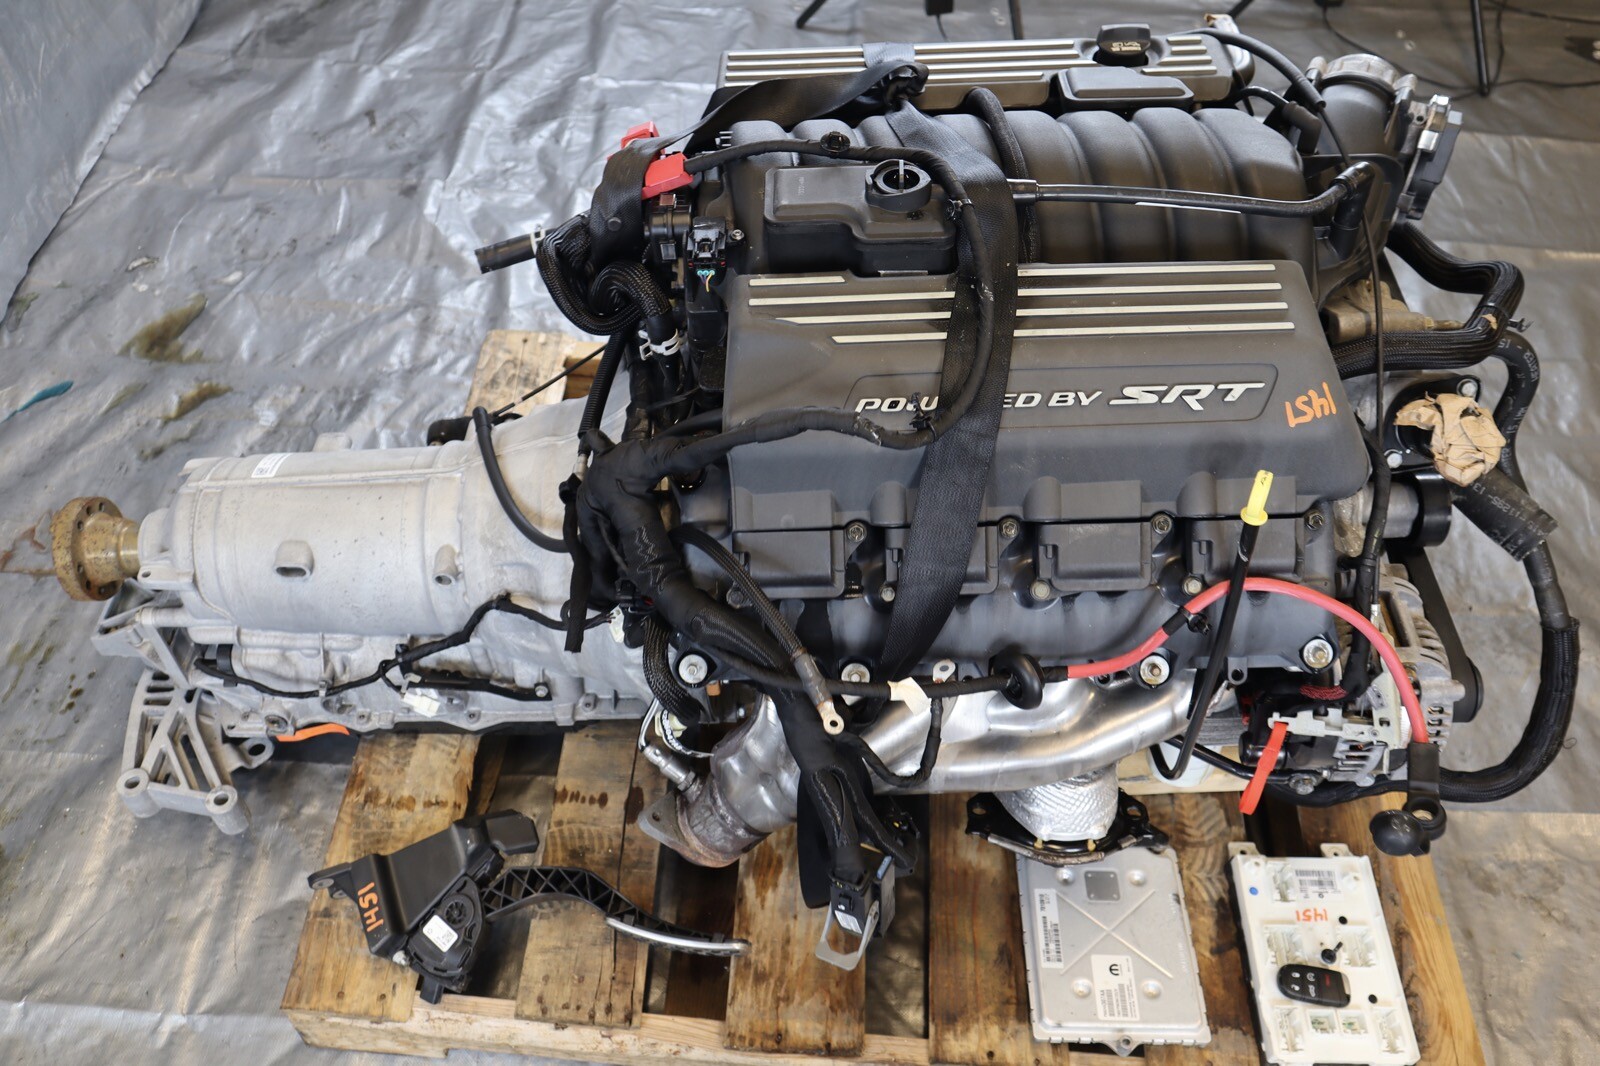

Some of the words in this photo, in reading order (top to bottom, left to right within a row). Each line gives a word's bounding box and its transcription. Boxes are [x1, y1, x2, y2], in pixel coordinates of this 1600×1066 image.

[1048, 391, 1102, 409] BY
[1108, 382, 1265, 411] SRT
[1295, 908, 1328, 923] 1451
